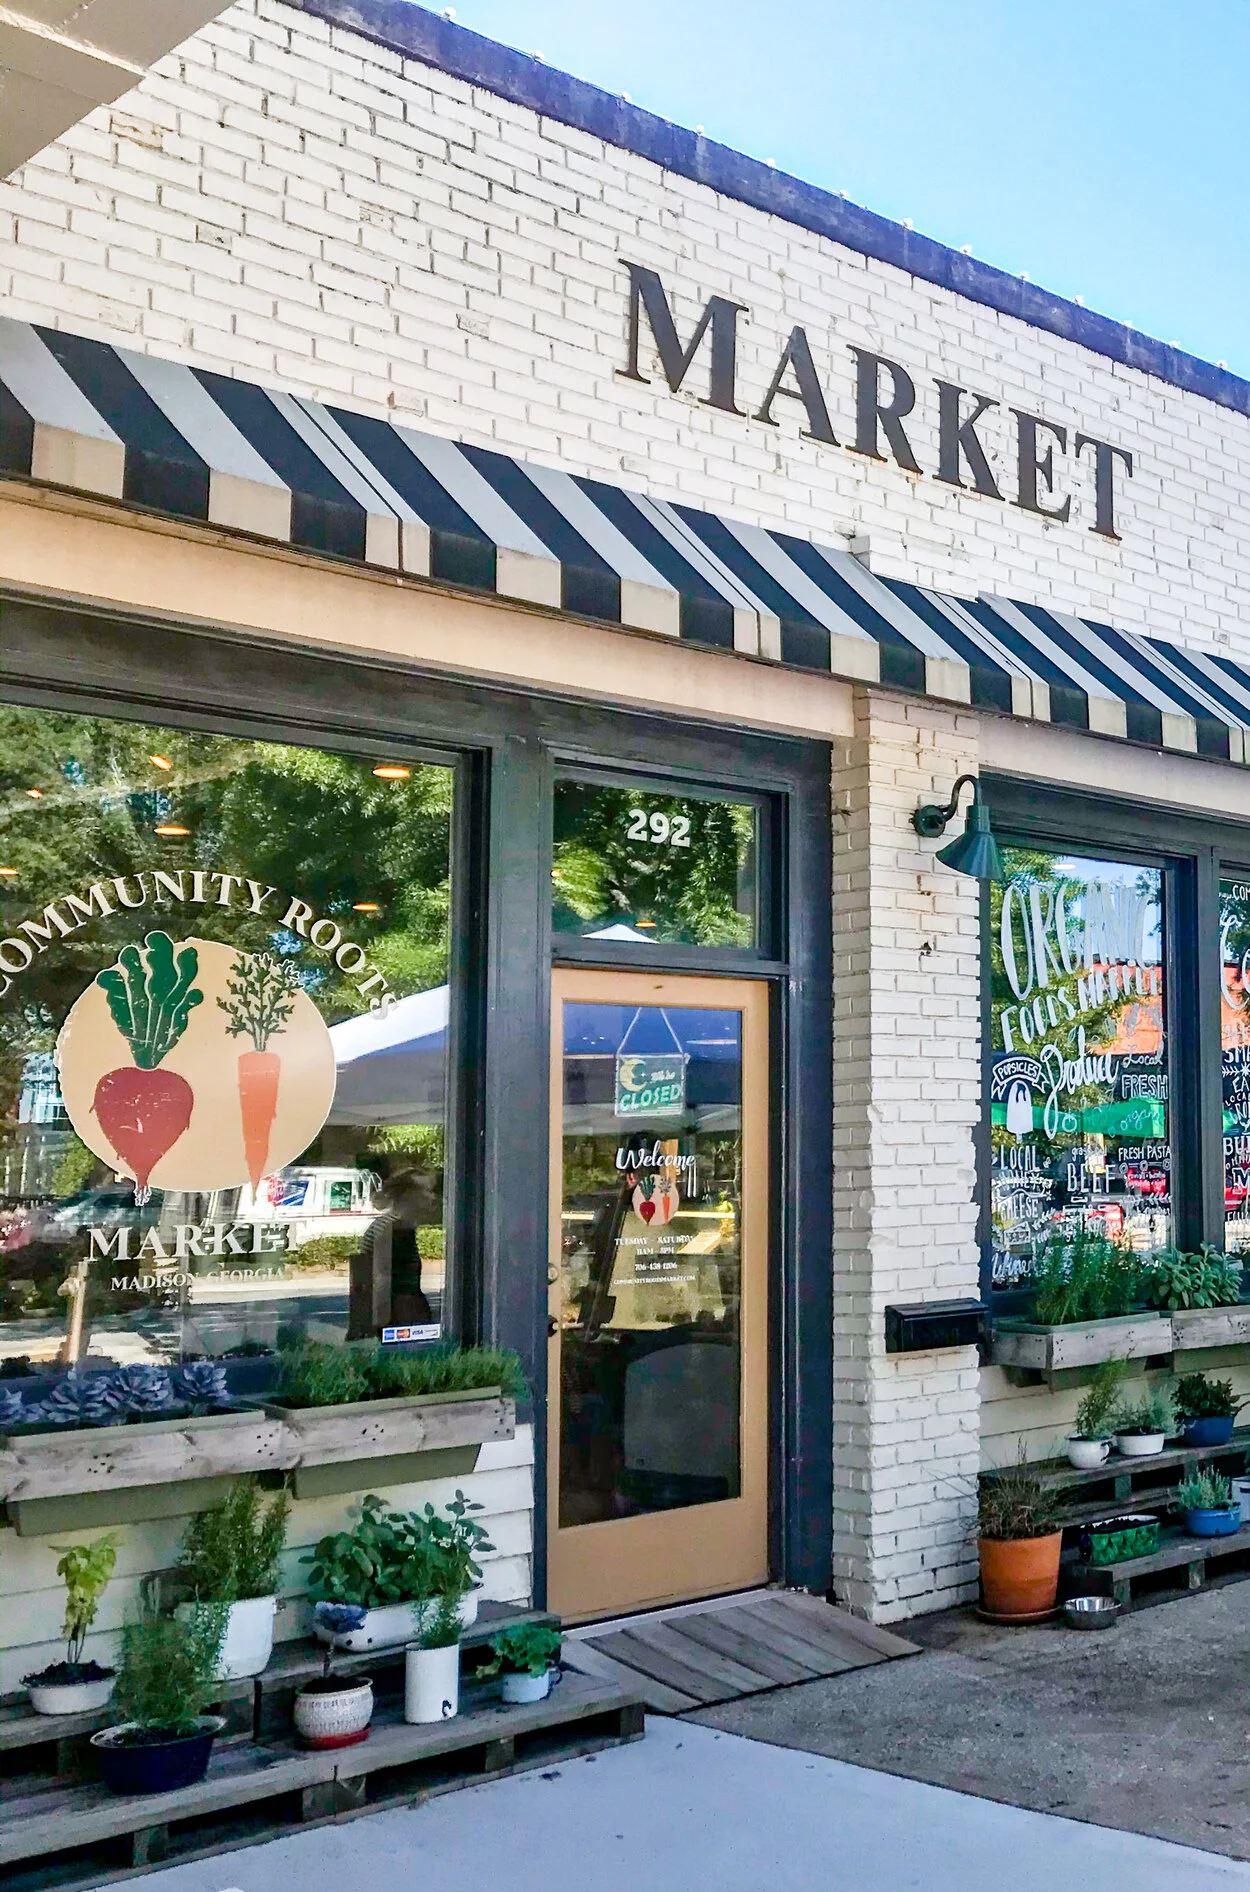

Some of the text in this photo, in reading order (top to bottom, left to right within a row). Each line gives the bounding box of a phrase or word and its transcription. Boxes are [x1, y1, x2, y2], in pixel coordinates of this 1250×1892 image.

[615, 258, 1133, 541] MARKET
[627, 809, 690, 847] 292
[1000, 883, 1162, 1000] ORGANIC
[278, 896, 398, 1021] ROOTS
[1001, 986, 1076, 1053] FOODS
[1122, 1041, 1164, 1069] Local
[998, 1063, 1039, 1082] POPSICLES
[1040, 1024, 1120, 1140] Produce
[1122, 1075, 1168, 1099] FRESH
[620, 1084, 681, 1111] CLOSED
[616, 1140, 696, 1171] Welcome
[1001, 1145, 1041, 1171] LOCAL
[1118, 1146, 1144, 1161] FRESH
[1147, 1145, 1171, 1161] PASTA
[1067, 1163, 1116, 1194] BEEF
[1000, 1193, 1039, 1221] CHEESE
[87, 1222, 299, 1262] MARKET
